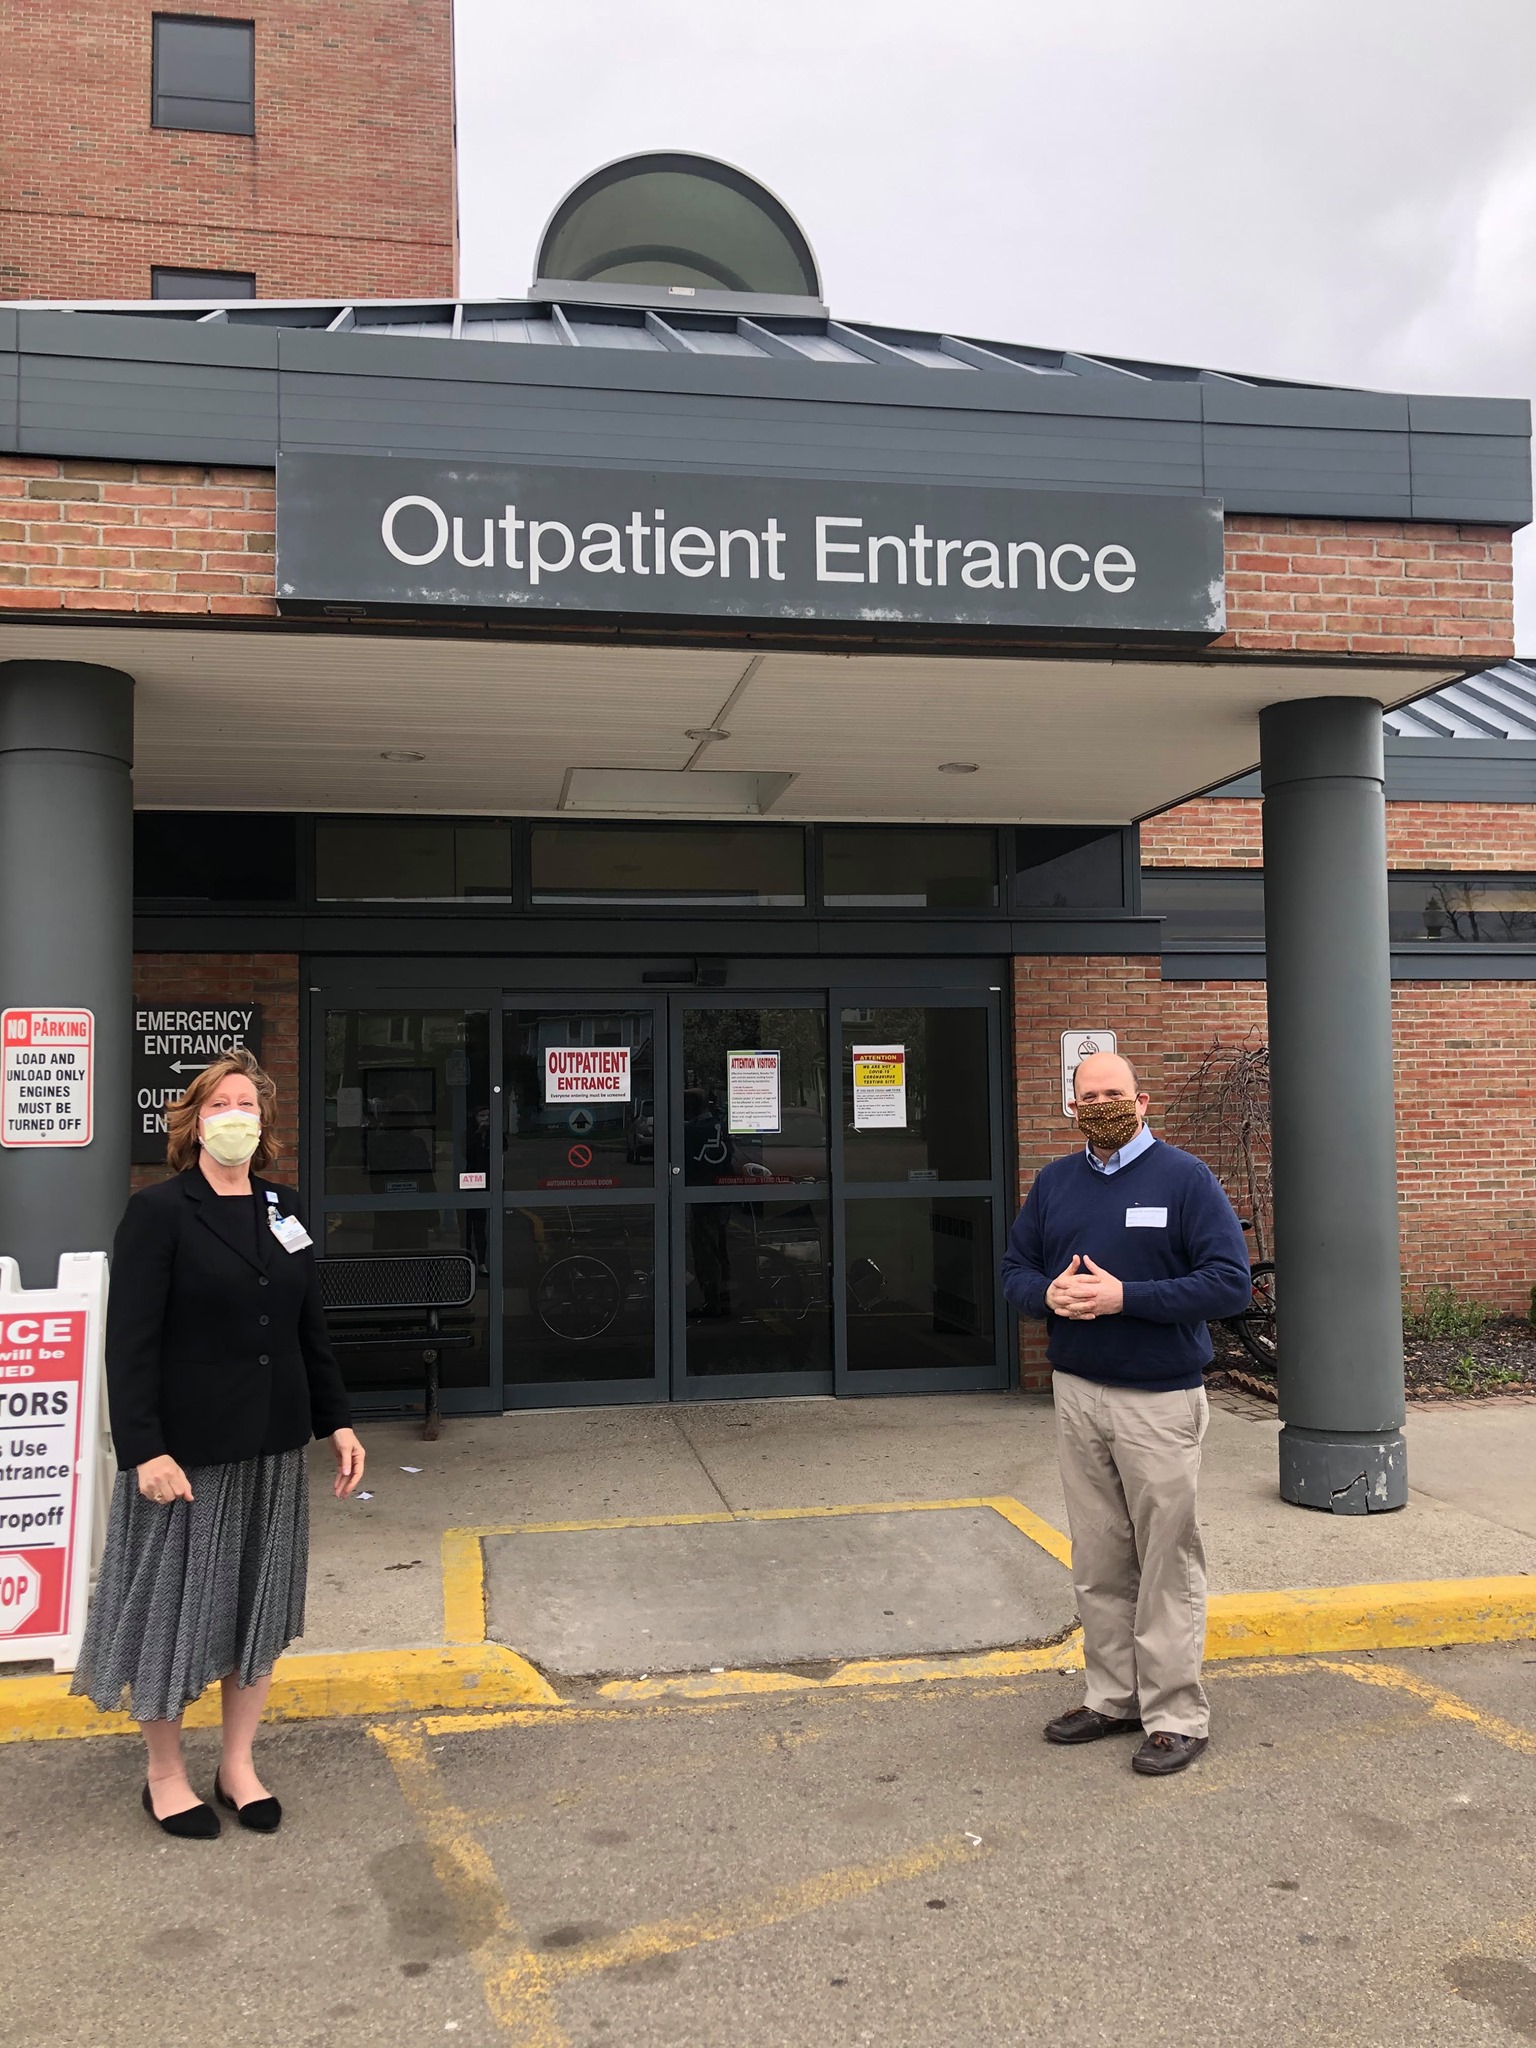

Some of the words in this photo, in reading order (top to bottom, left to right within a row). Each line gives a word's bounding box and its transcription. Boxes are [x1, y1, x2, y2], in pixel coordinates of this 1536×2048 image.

[381, 494, 787, 585] Outpatient
[815, 515, 1137, 594] Entrance
[136, 1010, 253, 1032] EMERGENCY
[7, 1018, 28, 1040] NO
[33, 1021, 87, 1037] PARKING
[144, 1034, 245, 1055] ENTRANCE
[16, 1053, 46, 1065] LOAD
[50, 1053, 75, 1065] AND
[548, 1051, 628, 1074] OUTPATIENT
[731, 1057, 755, 1069] ATTENTION
[757, 1057, 776, 1069] VISITORS
[7, 1069, 52, 1082] UNLOAD
[55, 1069, 86, 1081] ONLY
[557, 1076, 620, 1090] ENTRANCE
[20, 1085, 71, 1098] ENGINES
[18, 1102, 52, 1114] MUST
[56, 1102, 72, 1114] BE
[8, 1118, 54, 1131] TURNED
[58, 1118, 82, 1131] OFF
[463, 1175, 483, 1183] ATM
[39, 1348, 65, 1360] be
[11, 1440, 47, 1457] Use
[0, 1575, 28, 1607] OP
